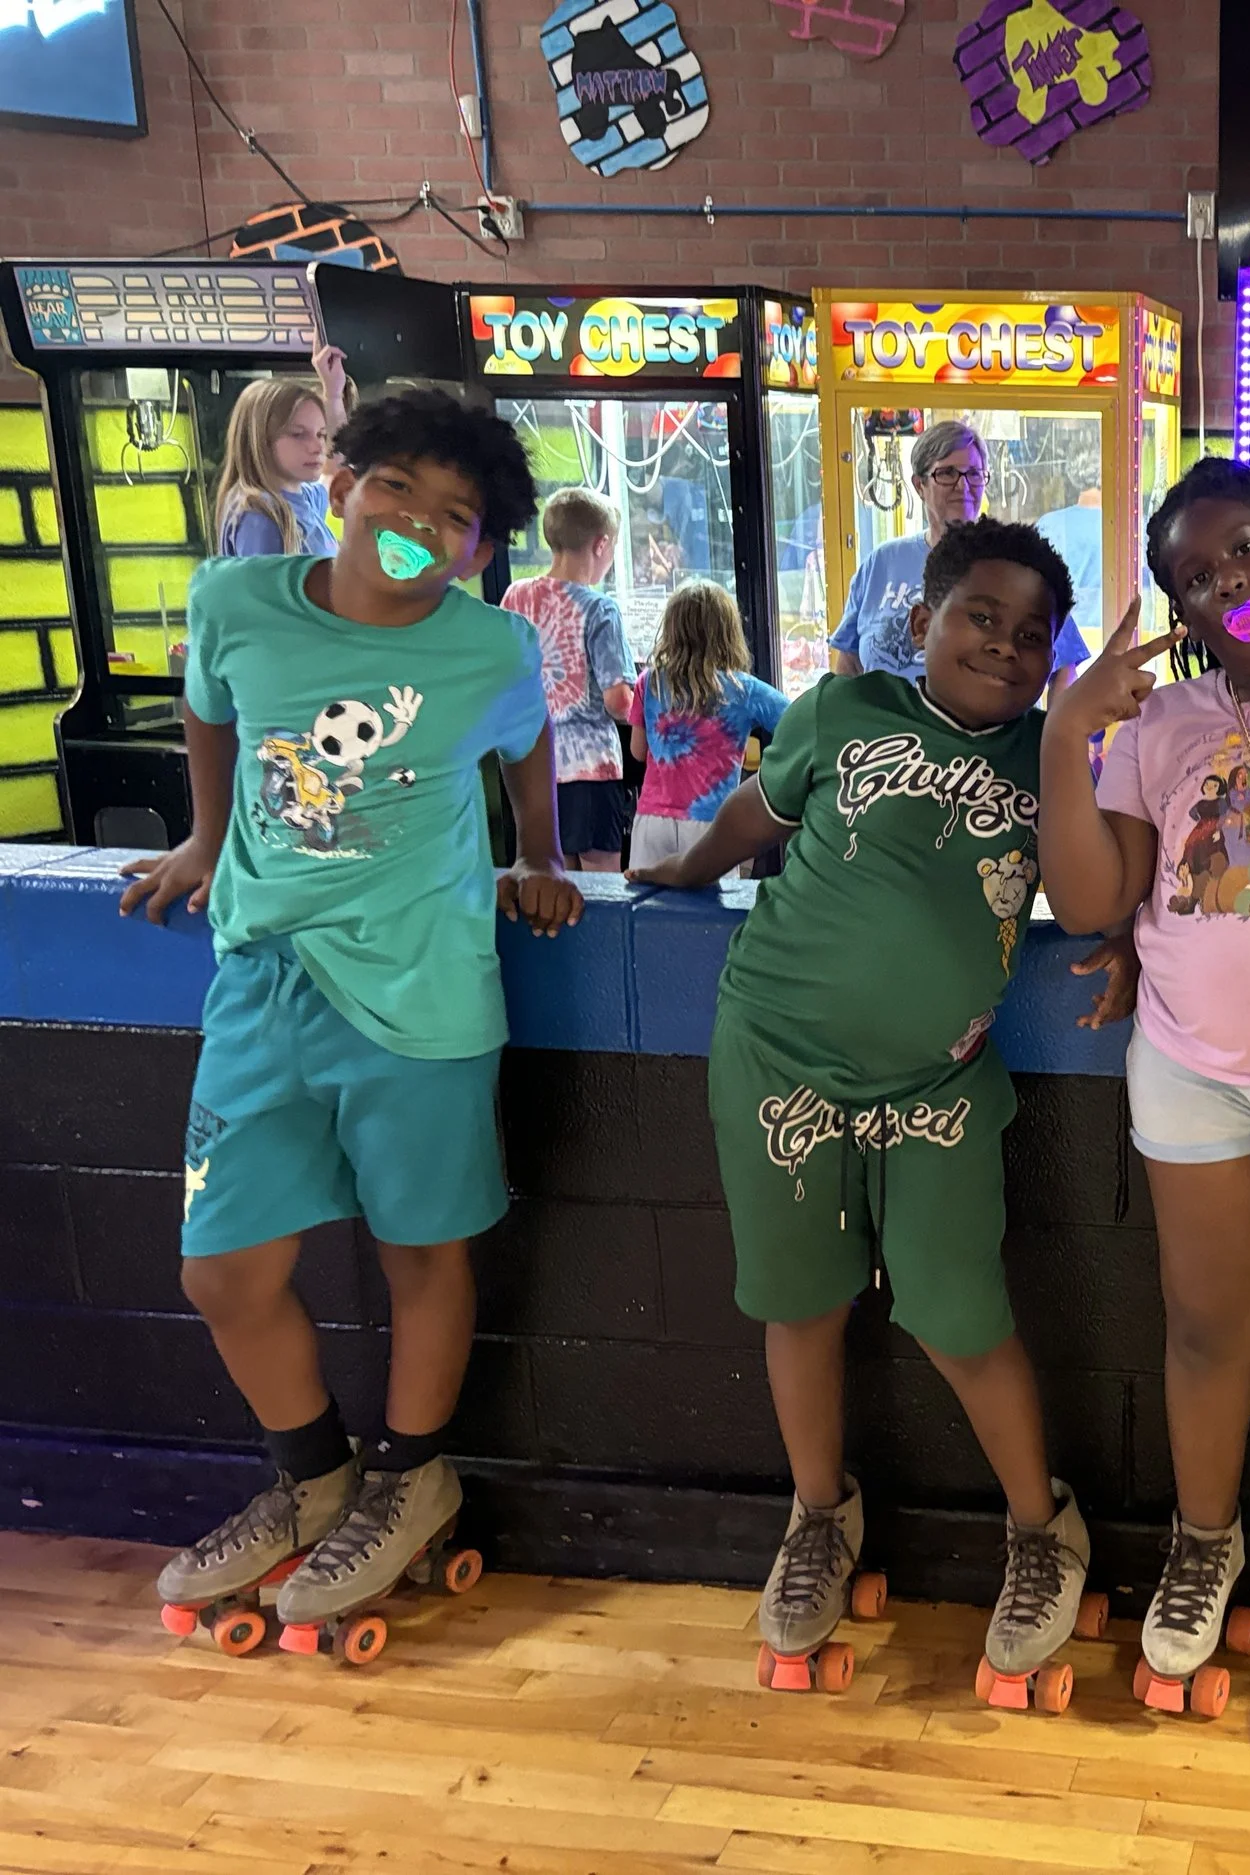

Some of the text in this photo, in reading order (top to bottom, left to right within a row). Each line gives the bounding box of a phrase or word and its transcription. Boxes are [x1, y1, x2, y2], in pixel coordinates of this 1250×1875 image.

[483, 310, 725, 364] TOY CHEST
[769, 323, 803, 364] TOY
[844, 320, 935, 369] TOY
[949, 321, 1103, 373] CHEST
[836, 733, 1039, 838] Civilize
